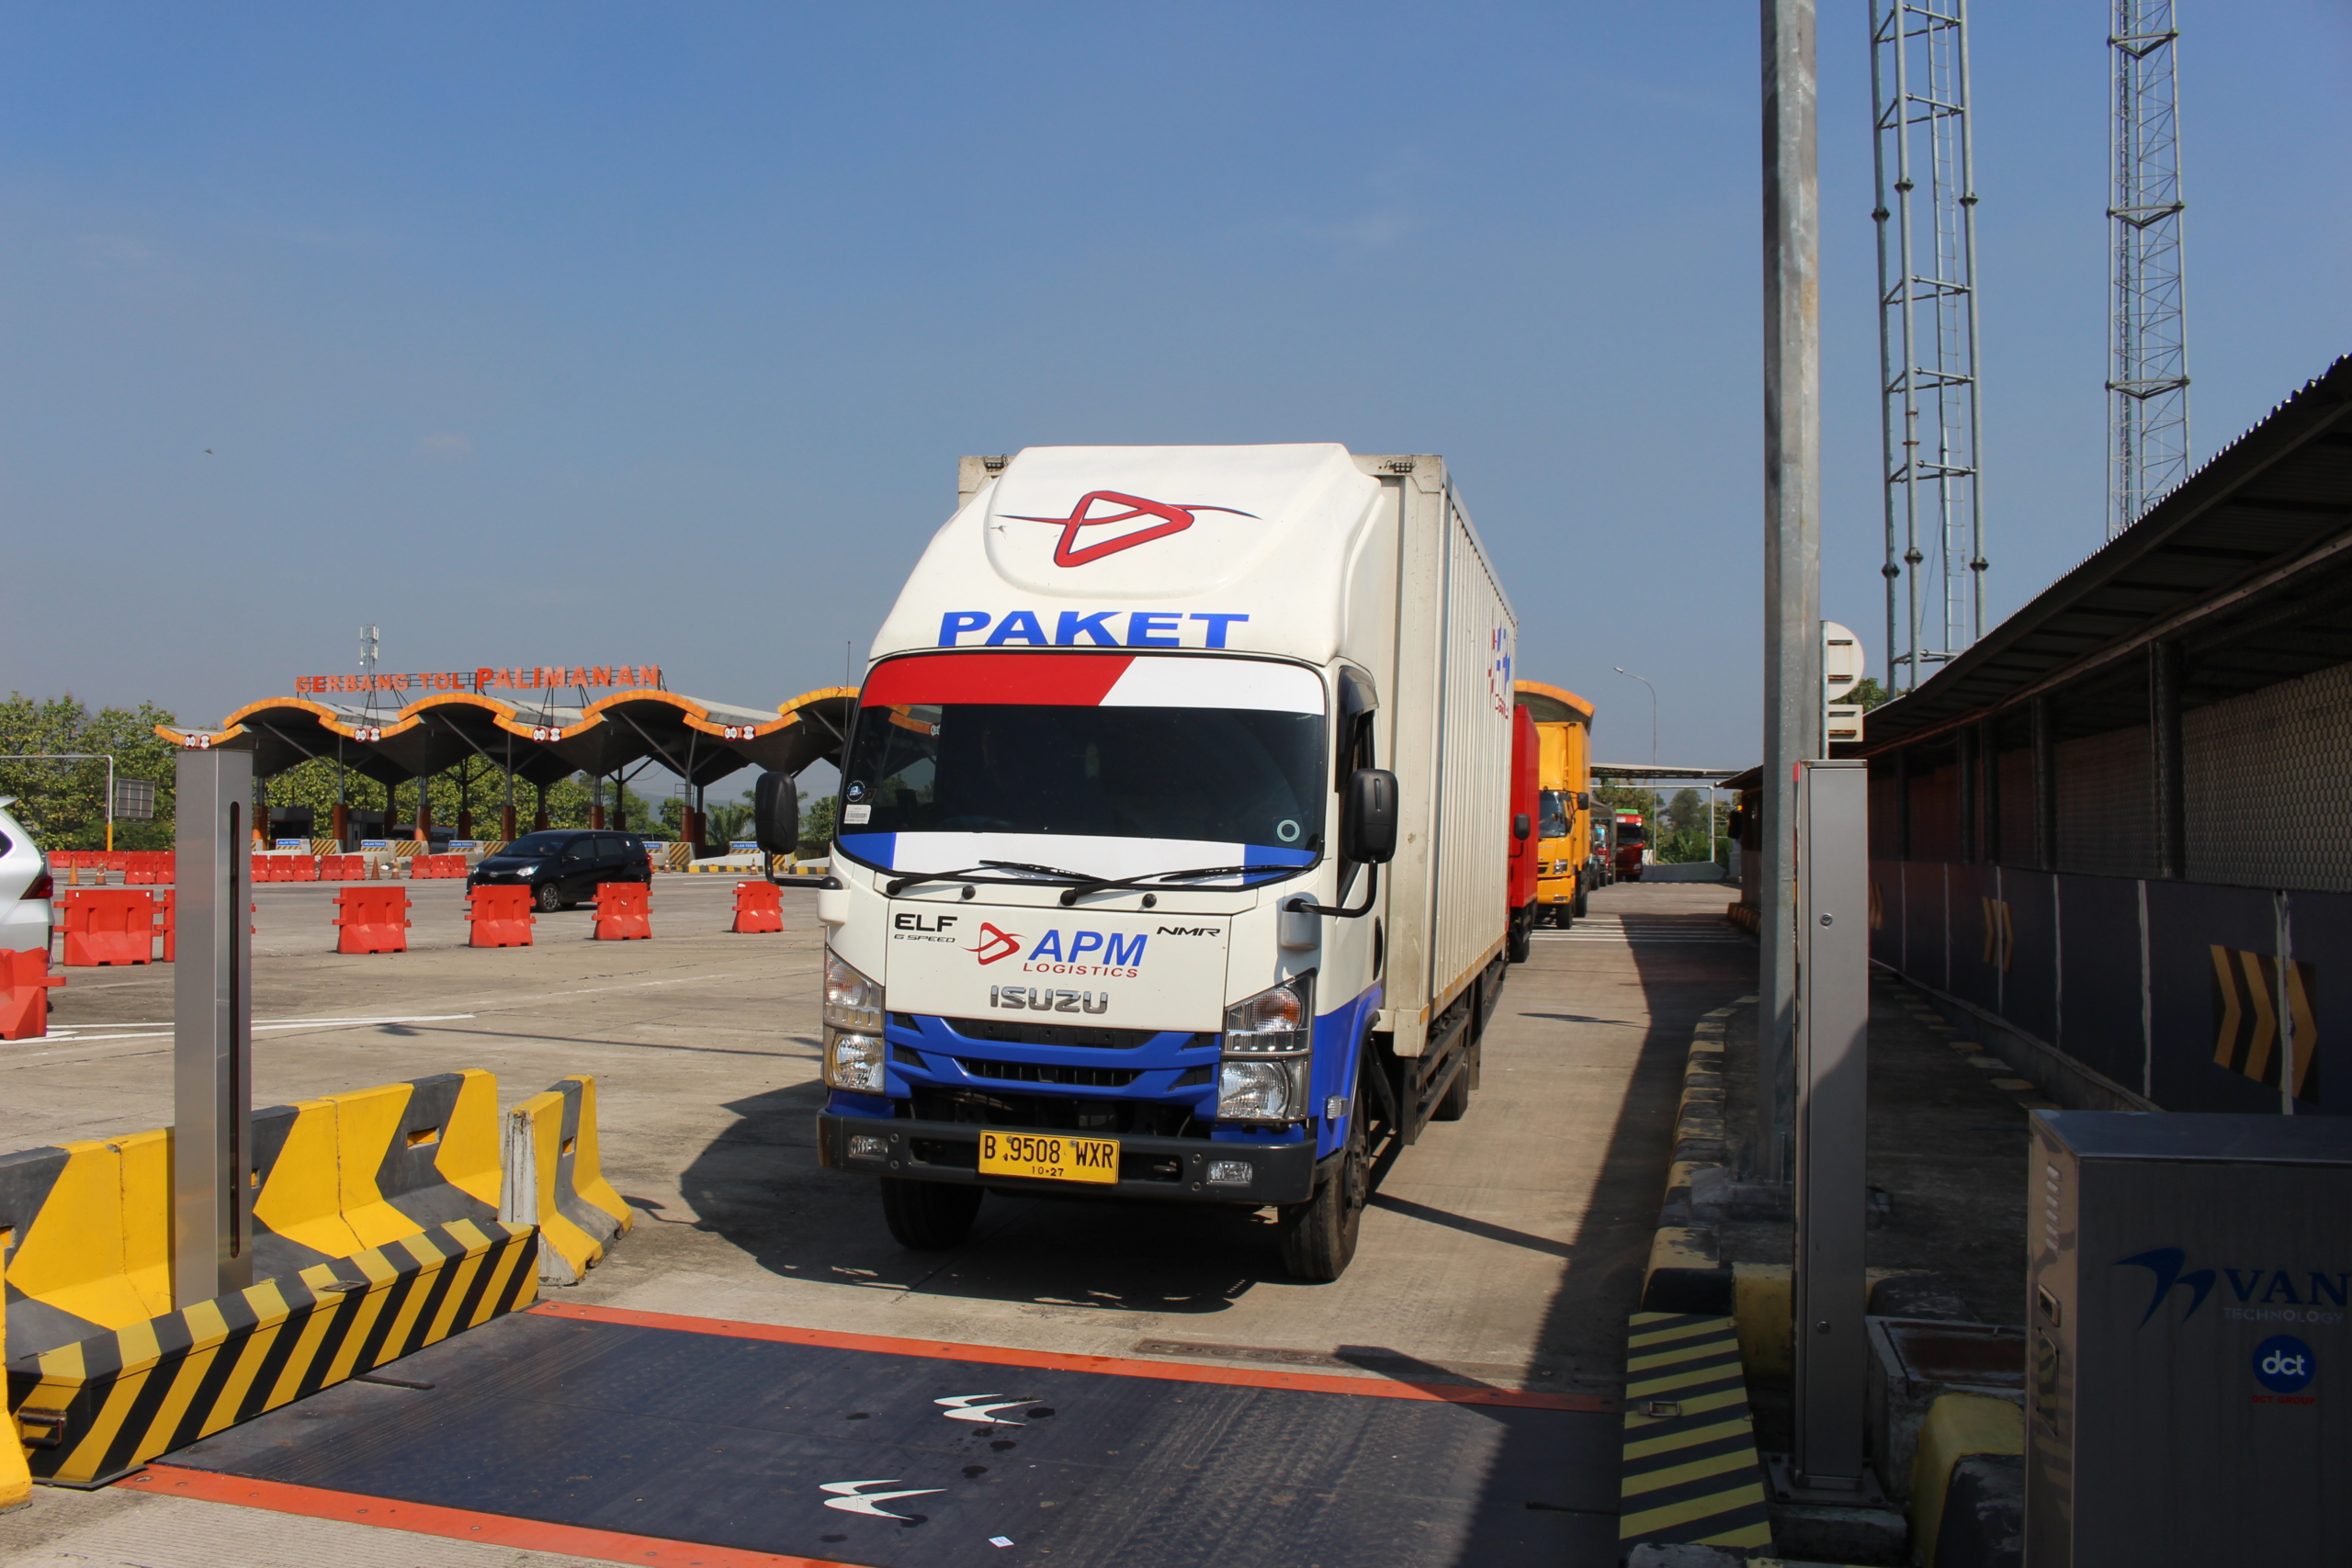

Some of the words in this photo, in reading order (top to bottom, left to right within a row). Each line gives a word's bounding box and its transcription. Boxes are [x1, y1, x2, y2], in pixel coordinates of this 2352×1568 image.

[937, 610, 1250, 649] PAKET
[295, 673, 410, 694] GERBANG
[418, 672, 466, 690] TOL
[476, 664, 660, 689] PALIMANAN
[895, 913, 958, 932] ELF
[1156, 926, 1221, 937] NMR
[907, 934, 956, 942] SPEED
[1027, 929, 1148, 967] APM
[1023, 963, 1138, 978] LOGISTICS
[990, 985, 1108, 1014] ISUZU
[984, 1134, 997, 1159] B
[1010, 1136, 1061, 1164] 9508
[1076, 1141, 1114, 1168] WXR
[2222, 1307, 2346, 1325] TECHNOLOGY
[2262, 1349, 2305, 1376] dct
[2252, 1395, 2274, 1404] DCT
[2277, 1396, 2316, 1405] GROUP
